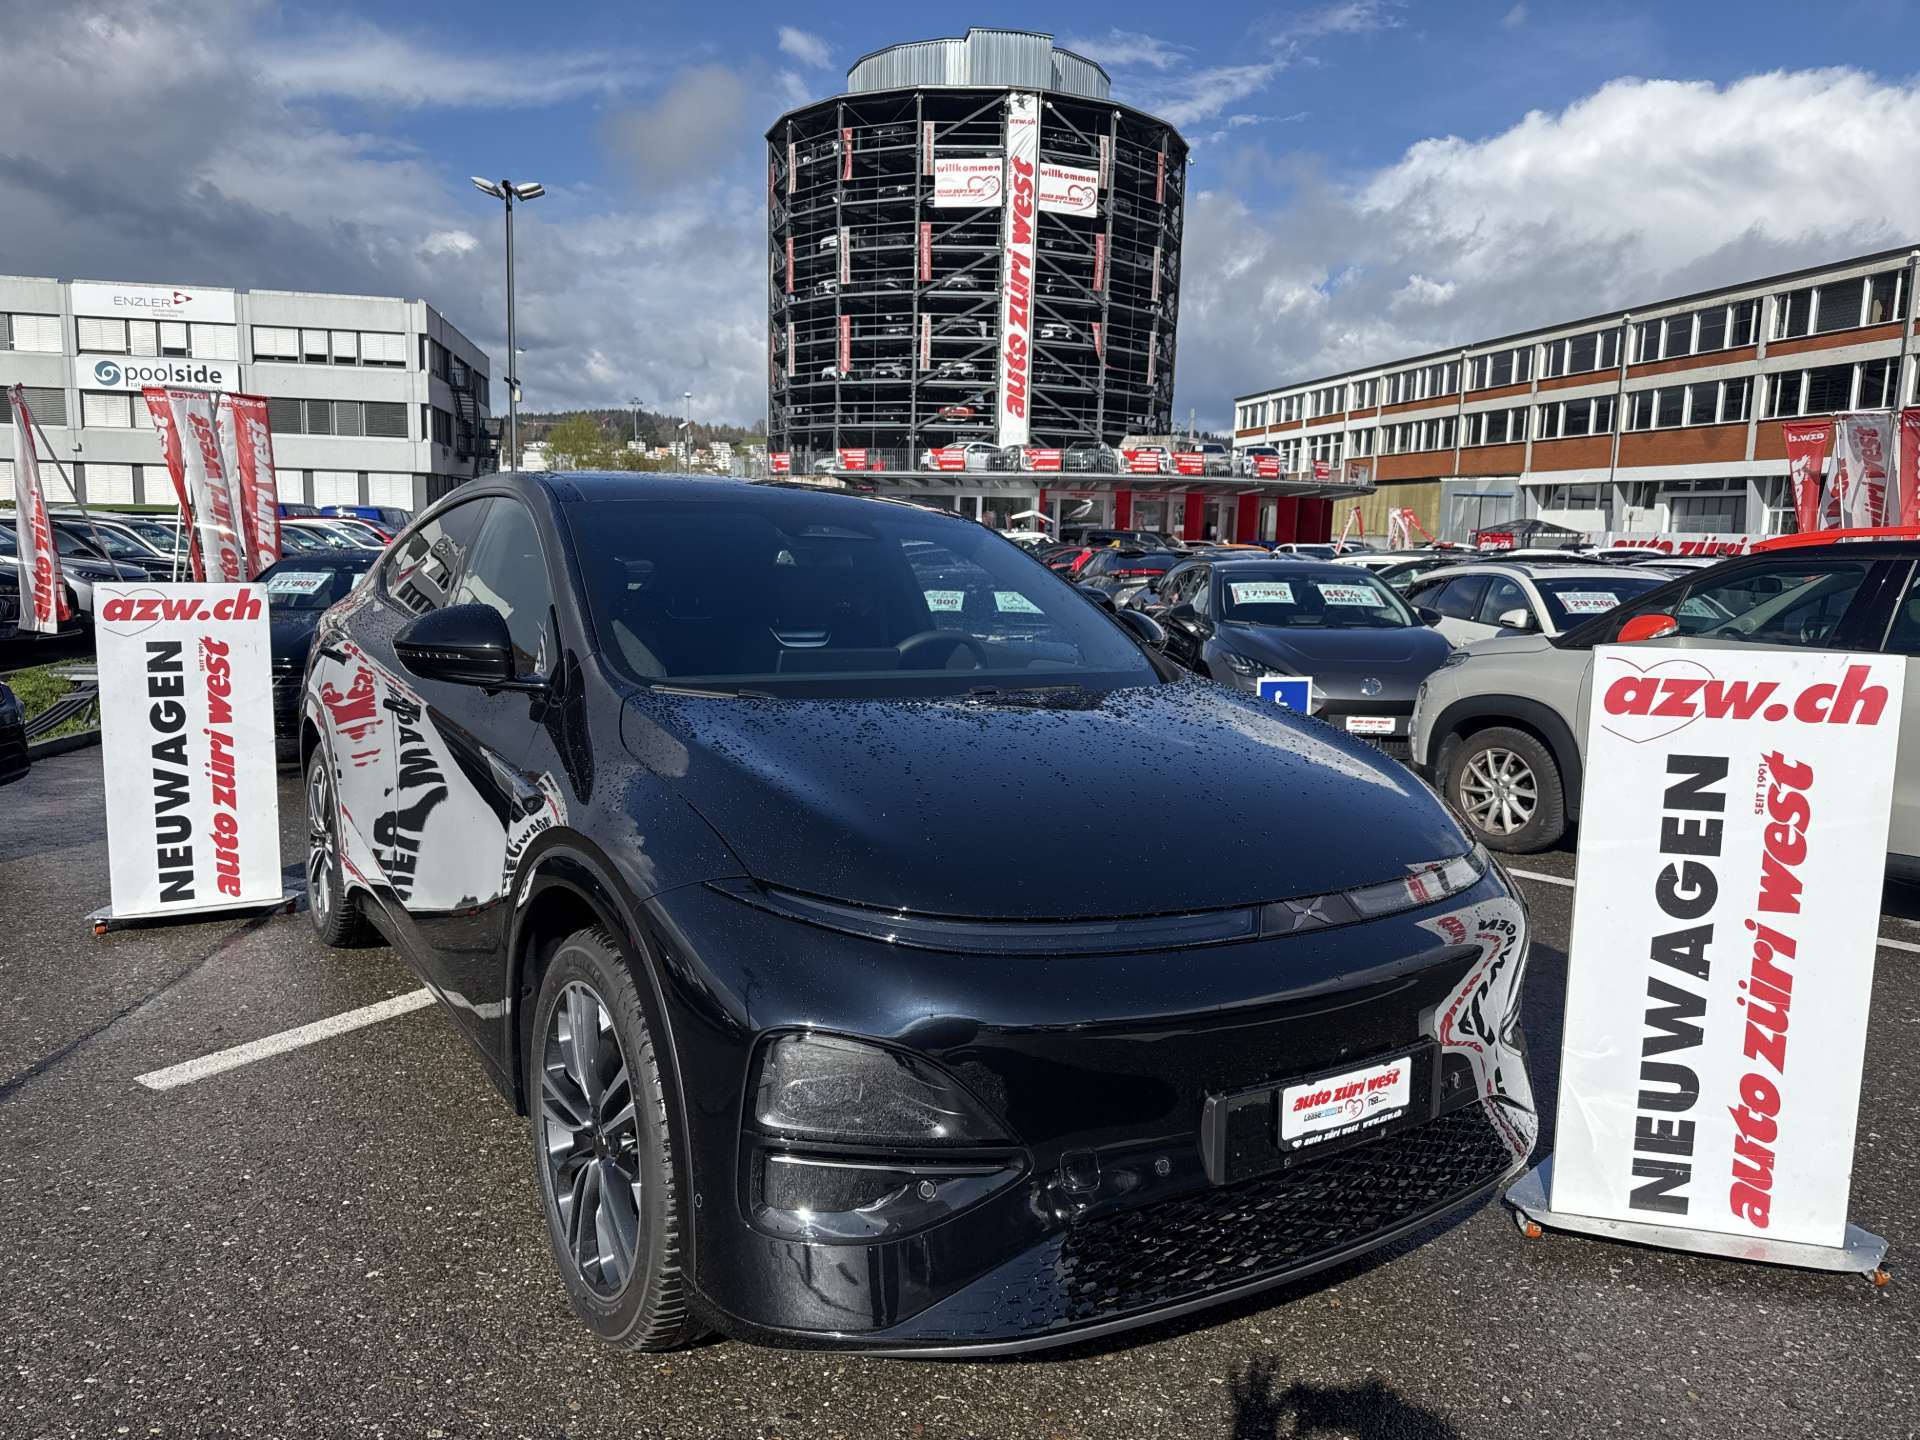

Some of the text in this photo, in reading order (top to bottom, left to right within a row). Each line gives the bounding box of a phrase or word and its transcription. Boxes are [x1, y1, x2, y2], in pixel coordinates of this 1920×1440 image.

[937, 163, 1000, 173] willkommen
[1040, 168, 1097, 184] willkommen
[113, 296, 171, 308] ENZLER
[1003, 155, 1034, 419] auto züri west
[124, 363, 222, 387] poolside
[187, 411, 223, 480] west
[249, 416, 273, 482] west
[250, 482, 276, 552] züri
[1679, 536, 1748, 556] züri
[102, 588, 262, 621] azw.ch
[1243, 589, 1287, 597] 17'950
[1323, 589, 1361, 598] 46%
[1602, 665, 1889, 725] azw.ch
[146, 640, 195, 903] NEUWAGEN
[200, 635, 241, 898] auto züri west
[1754, 763, 1768, 816] SEIT 1991
[1629, 753, 1729, 1216] NEUWAGEN
[1726, 750, 1815, 1229] auto züri west
[1293, 1088, 1331, 1112] auto
[1332, 1077, 1368, 1102] züri
[1367, 1069, 1401, 1092] west
[1303, 1134, 1323, 1146] auto
[1342, 1123, 1360, 1135] west
